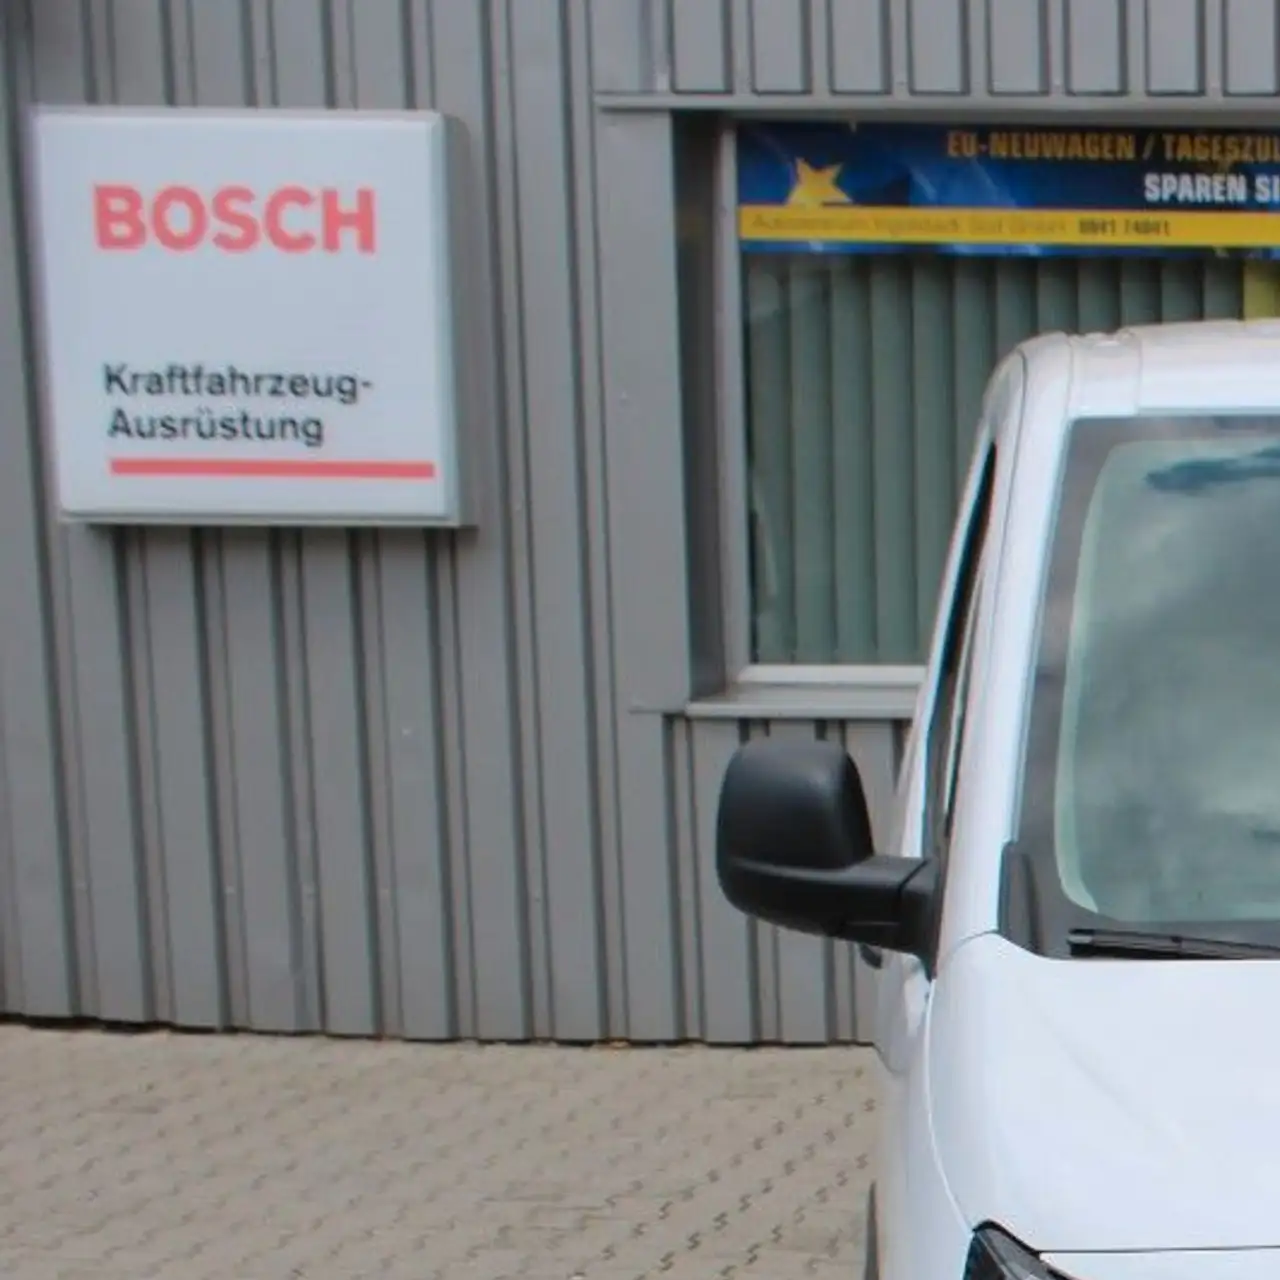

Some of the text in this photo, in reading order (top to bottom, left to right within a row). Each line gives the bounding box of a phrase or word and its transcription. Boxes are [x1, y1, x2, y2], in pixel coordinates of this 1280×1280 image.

[1144, 173, 1248, 204] SPAREN
[93, 184, 377, 254] BOSCH
[102, 364, 373, 404] Kraftfahrzeug-
[107, 408, 325, 447] Ausrüstung
